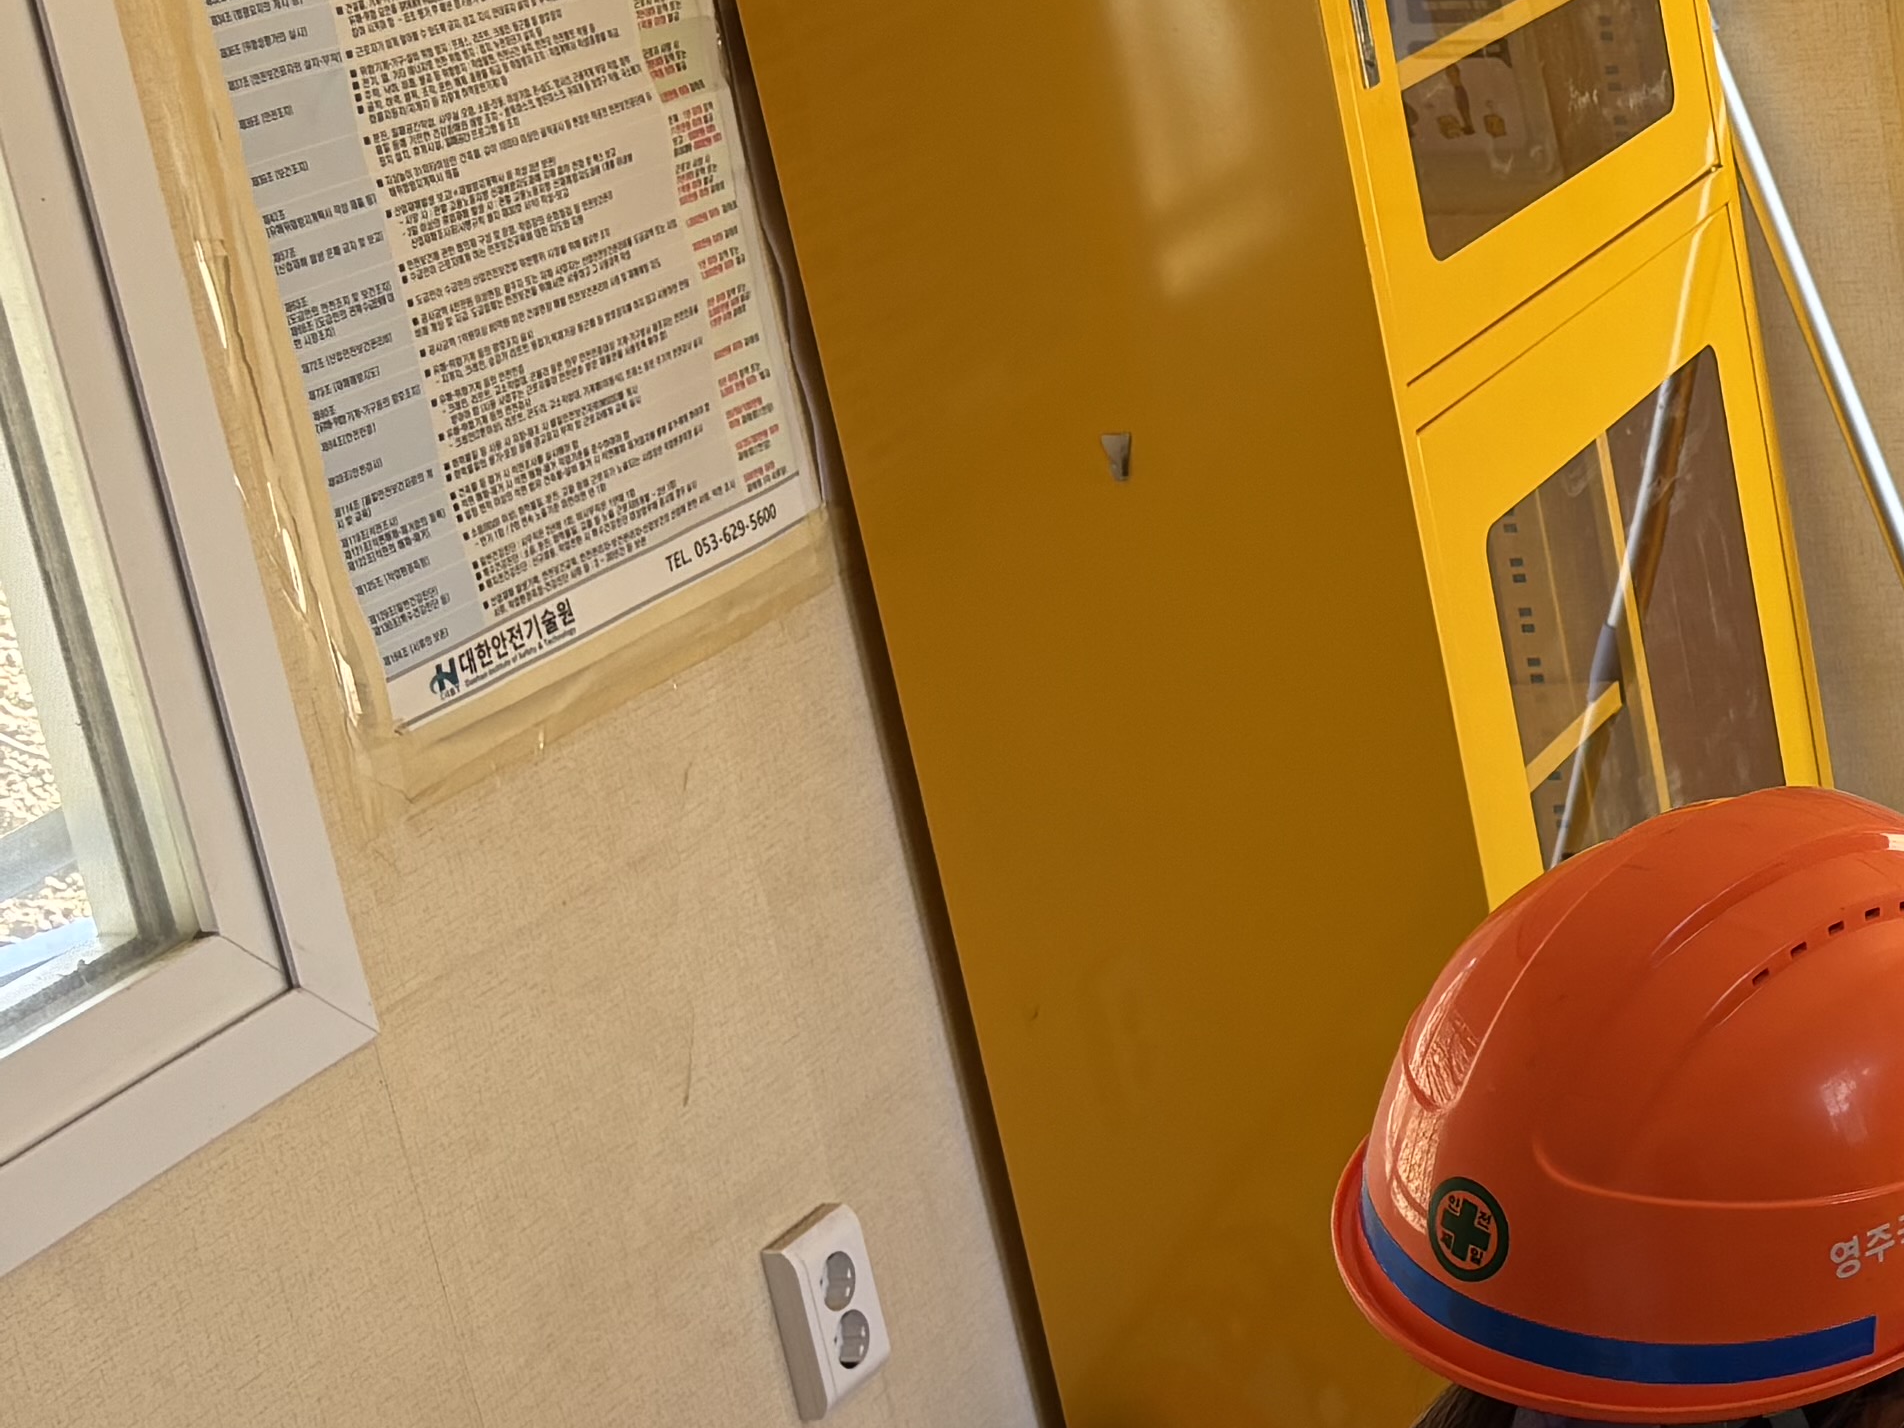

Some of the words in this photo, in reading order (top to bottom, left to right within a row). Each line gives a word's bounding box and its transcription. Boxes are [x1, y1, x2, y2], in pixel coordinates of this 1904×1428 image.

[665, 552, 693, 572] TEL.
[694, 503, 778, 558] 053-629-5600
[458, 597, 575, 674] 대한안전기술원
